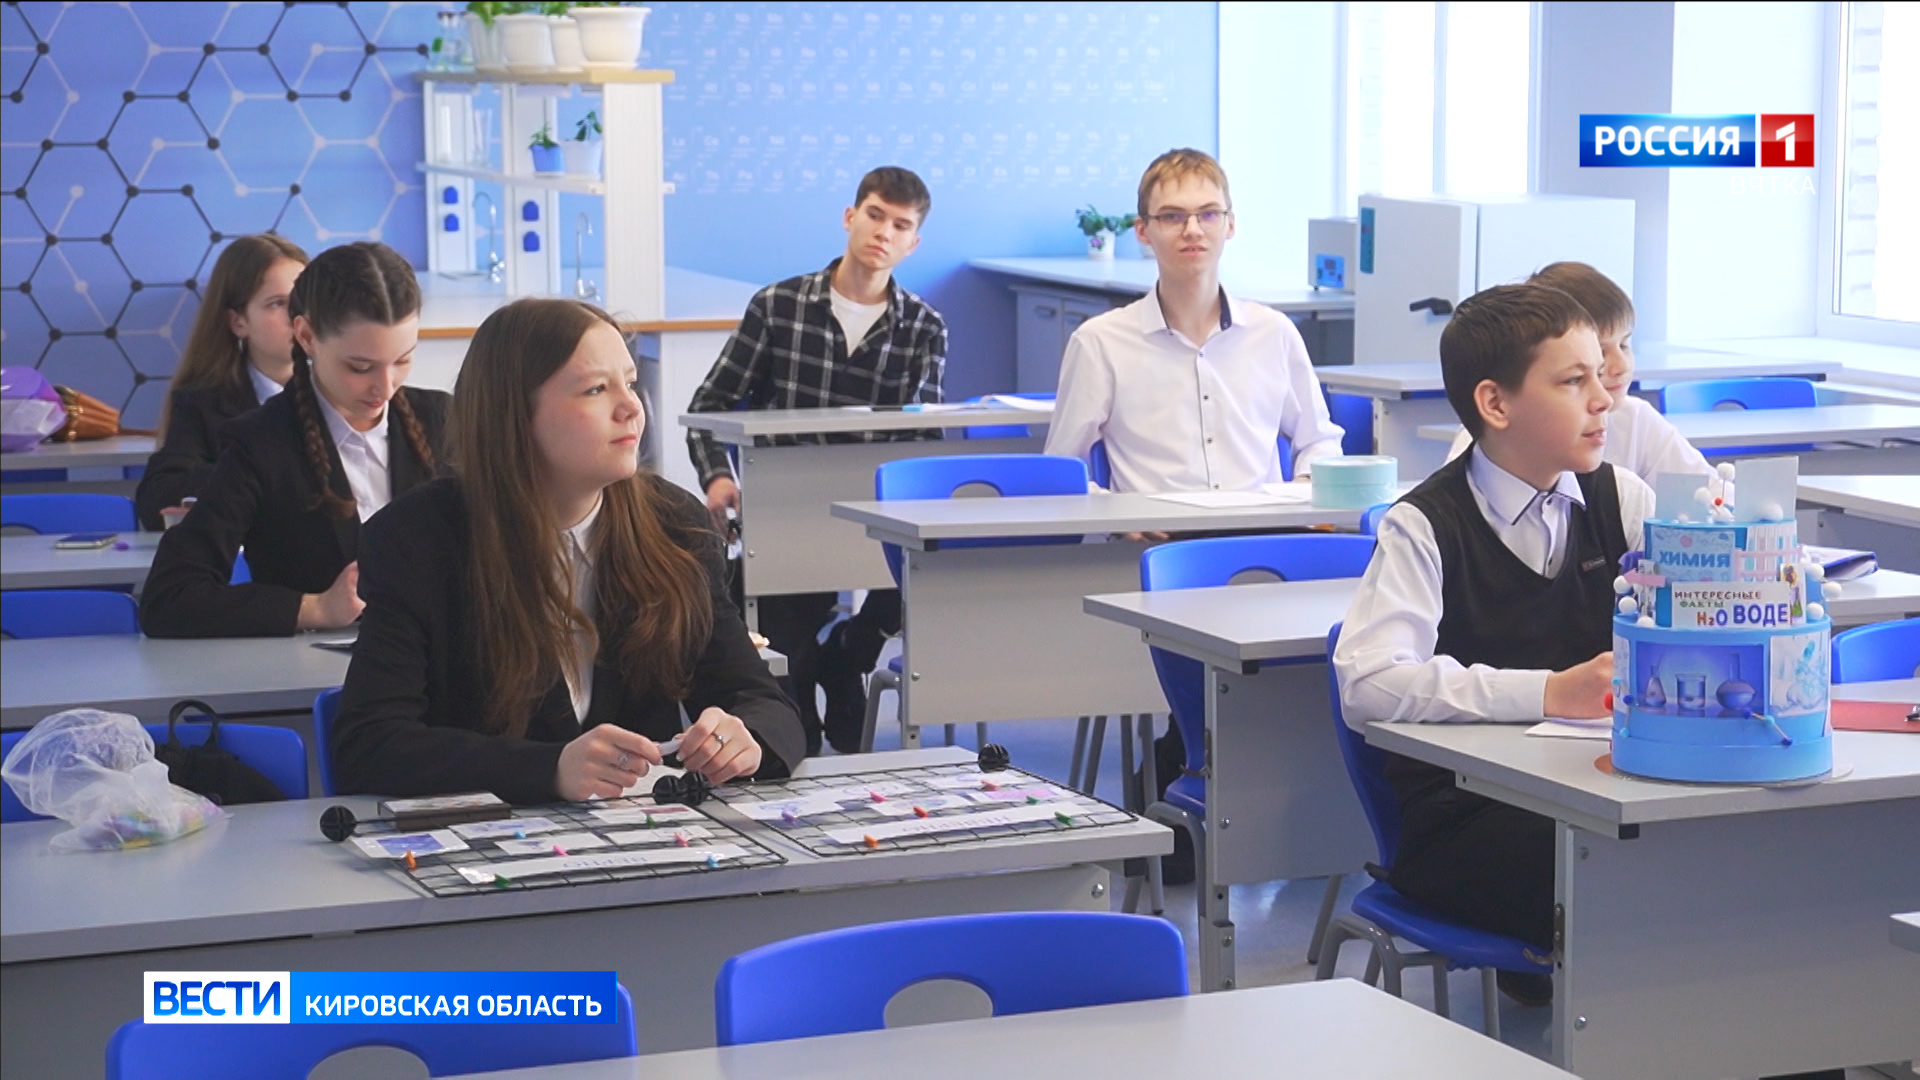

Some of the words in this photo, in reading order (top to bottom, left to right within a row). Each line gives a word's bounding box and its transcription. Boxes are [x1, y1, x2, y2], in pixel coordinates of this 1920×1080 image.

[1659, 549, 1731, 568] ХИМИЯ
[1674, 590, 1762, 600] ИНТЕРЕСНЫЕ
[1679, 599, 1724, 608] ФАКТЫ
[1732, 603, 1789, 627] ВОДЕ
